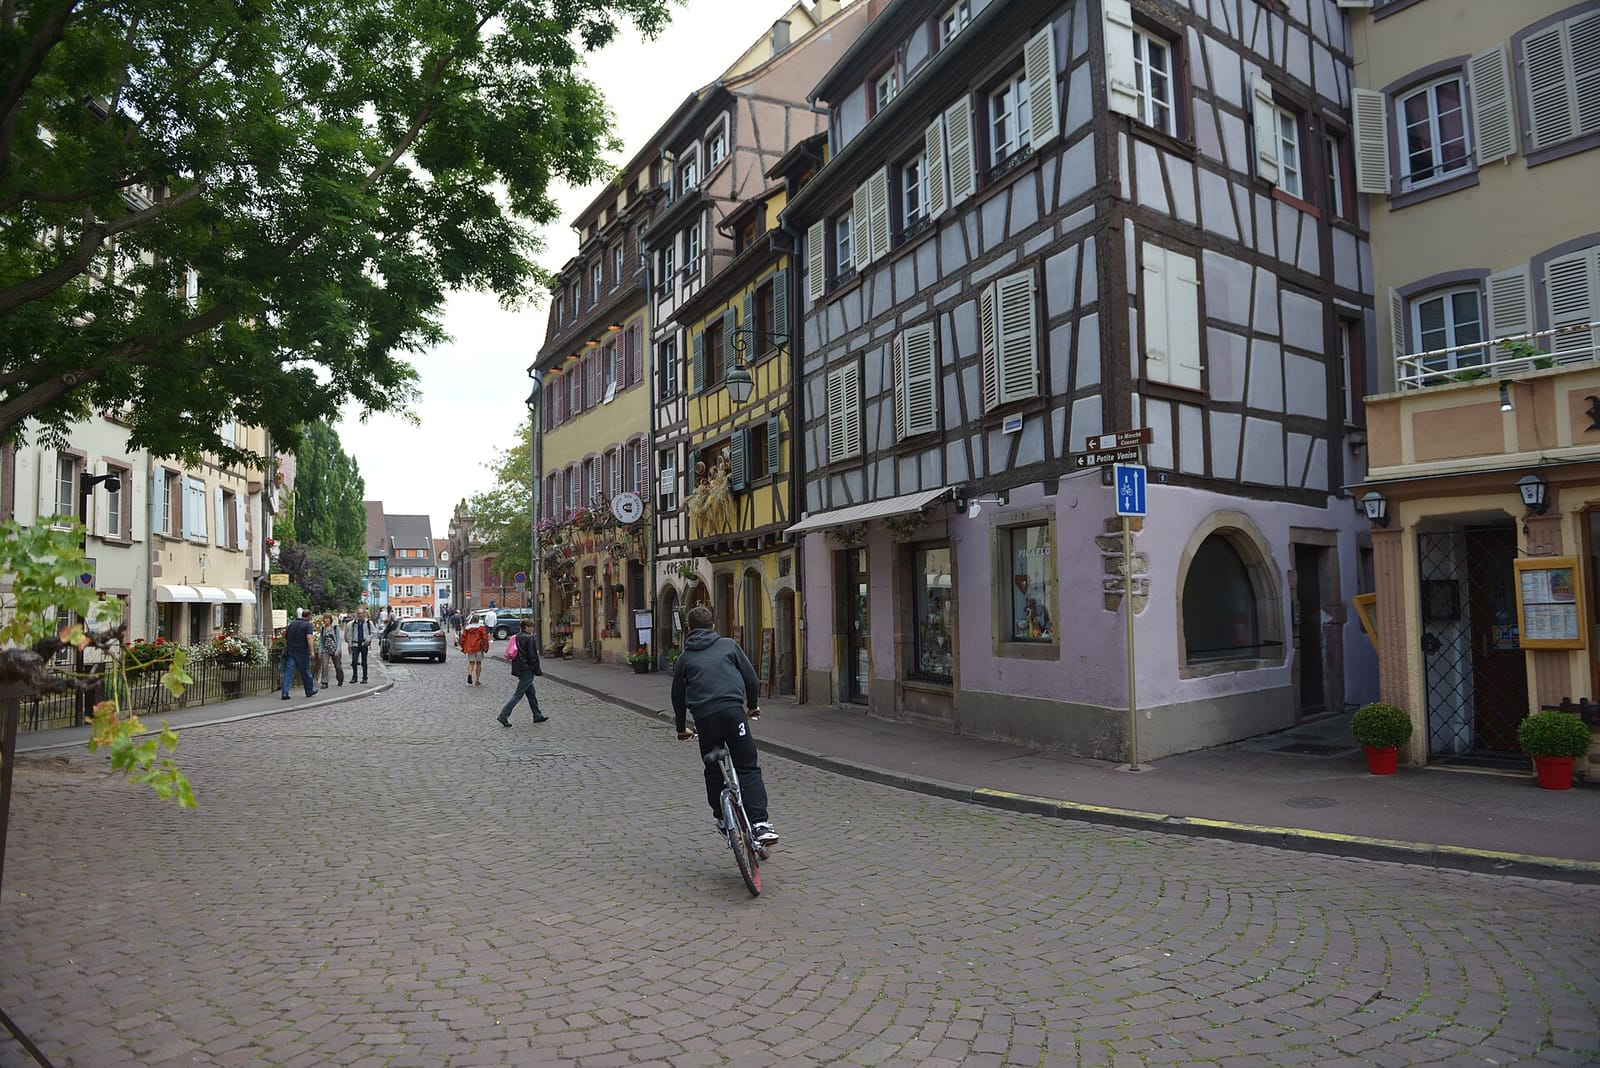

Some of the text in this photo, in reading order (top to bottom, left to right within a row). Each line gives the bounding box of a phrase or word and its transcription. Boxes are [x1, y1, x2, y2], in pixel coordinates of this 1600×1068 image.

[1096, 451, 1137, 462] Petite Venise
[738, 722, 746, 736] 3
